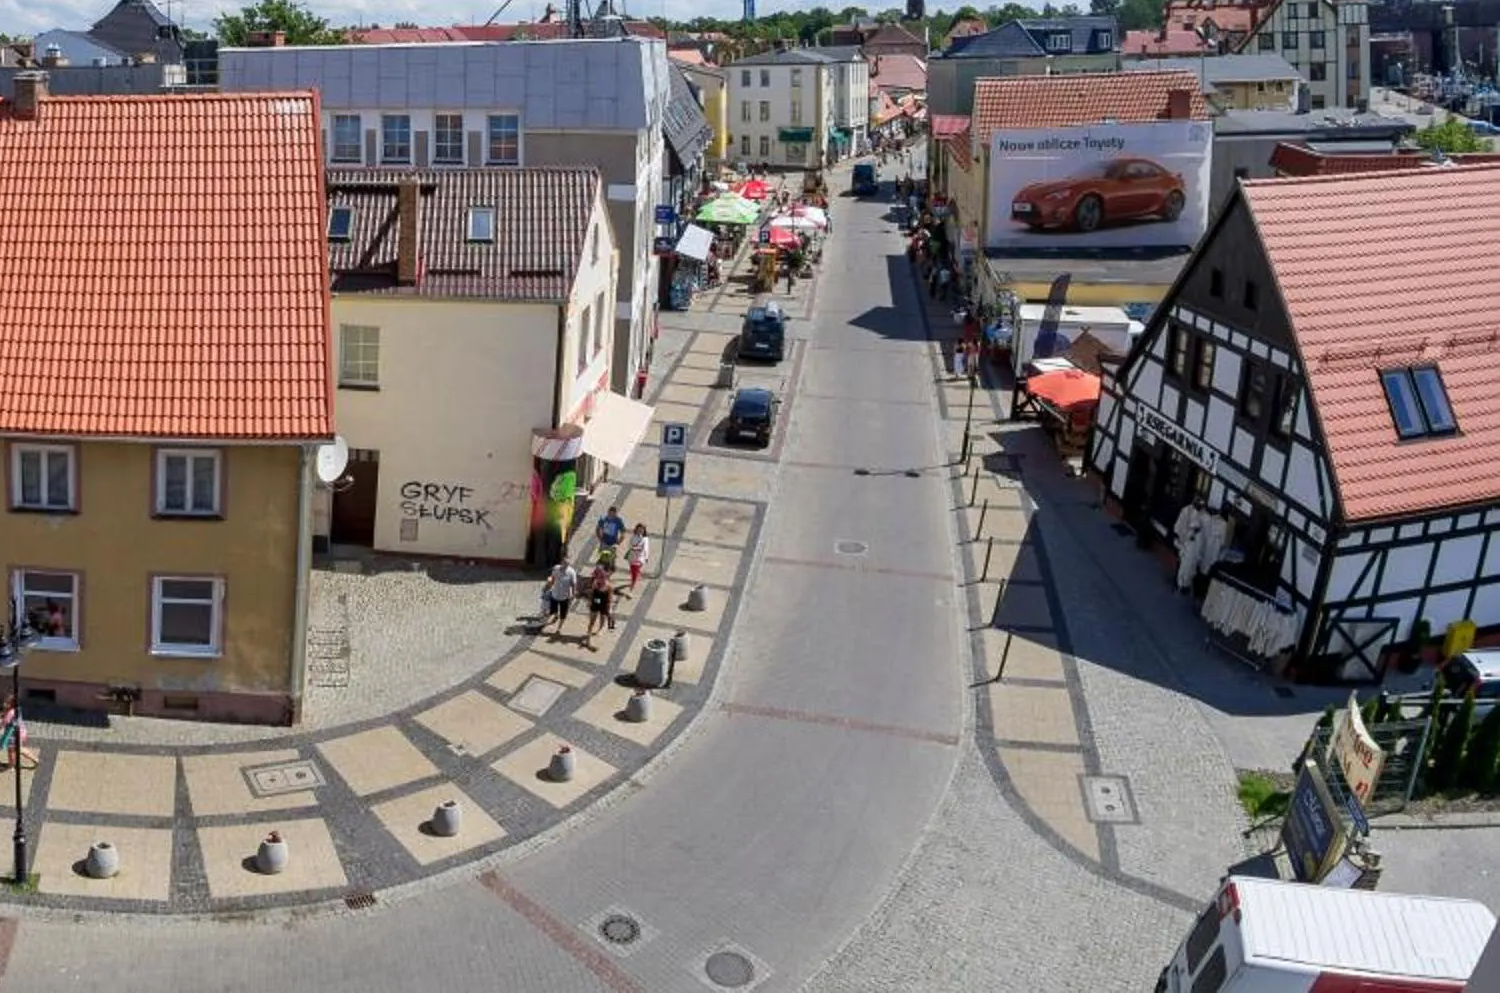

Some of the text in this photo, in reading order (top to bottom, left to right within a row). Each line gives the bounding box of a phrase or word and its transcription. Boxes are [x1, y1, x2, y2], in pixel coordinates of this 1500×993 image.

[999, 136, 1126, 152] Nowe oblicze Toyoty
[667, 428, 681, 444] P
[663, 462, 680, 484] P
[400, 480, 475, 504] GRYF
